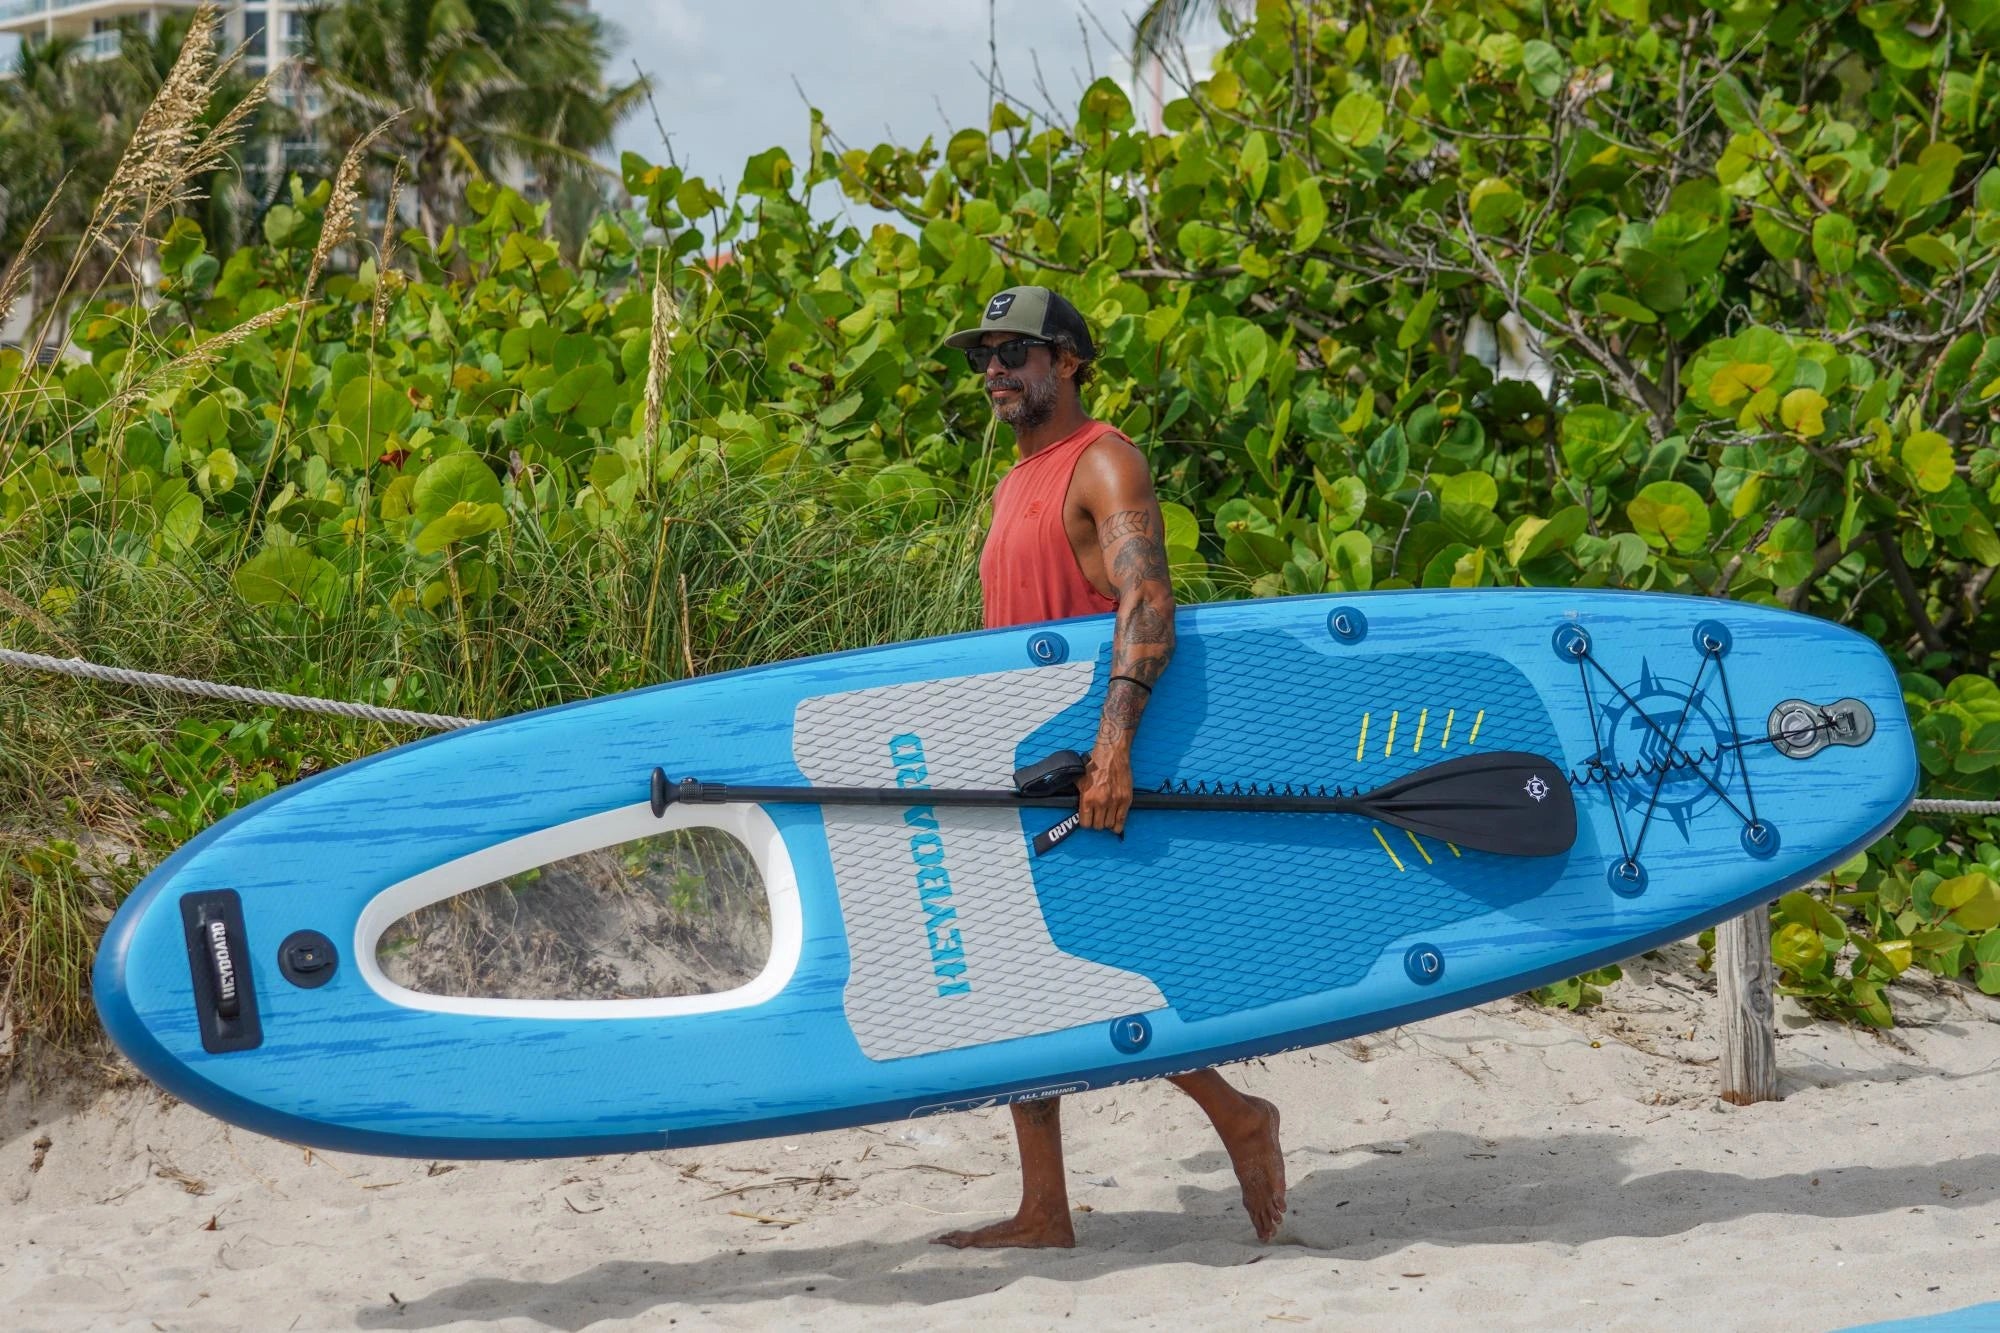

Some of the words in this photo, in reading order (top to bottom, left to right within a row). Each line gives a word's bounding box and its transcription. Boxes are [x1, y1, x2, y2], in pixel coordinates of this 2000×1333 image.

[887, 732, 972, 997] HEYBOARD
[211, 922, 236, 999] HEYBOARD
[1018, 1094, 1038, 1102] ALL
[1040, 1086, 1077, 1097] ROUND
